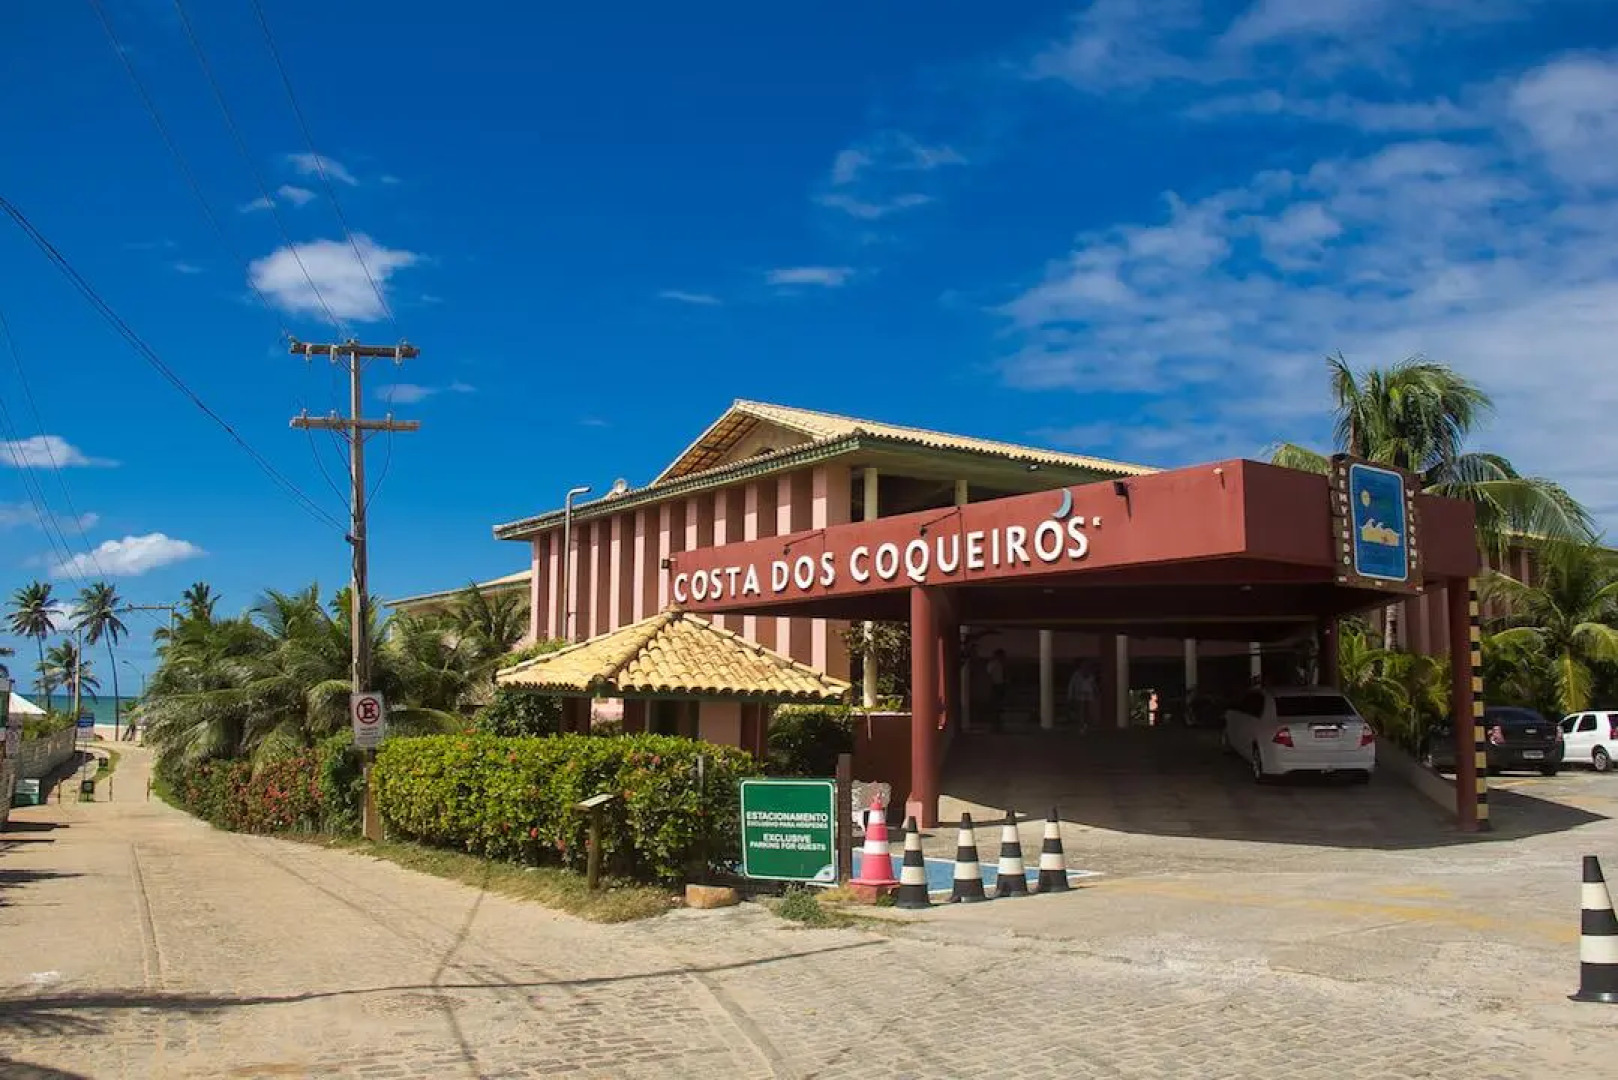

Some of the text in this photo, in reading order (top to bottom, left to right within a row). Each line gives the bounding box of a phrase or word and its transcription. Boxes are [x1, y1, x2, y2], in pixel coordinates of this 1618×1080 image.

[674, 516, 1088, 602] COSTA DOS COQUEIROS
[746, 811, 828, 822] ESTACIONAMENTO
[763, 833, 811, 843] EXCLUSIVE
[750, 841, 826, 851] PARKING FOR GUESTS
